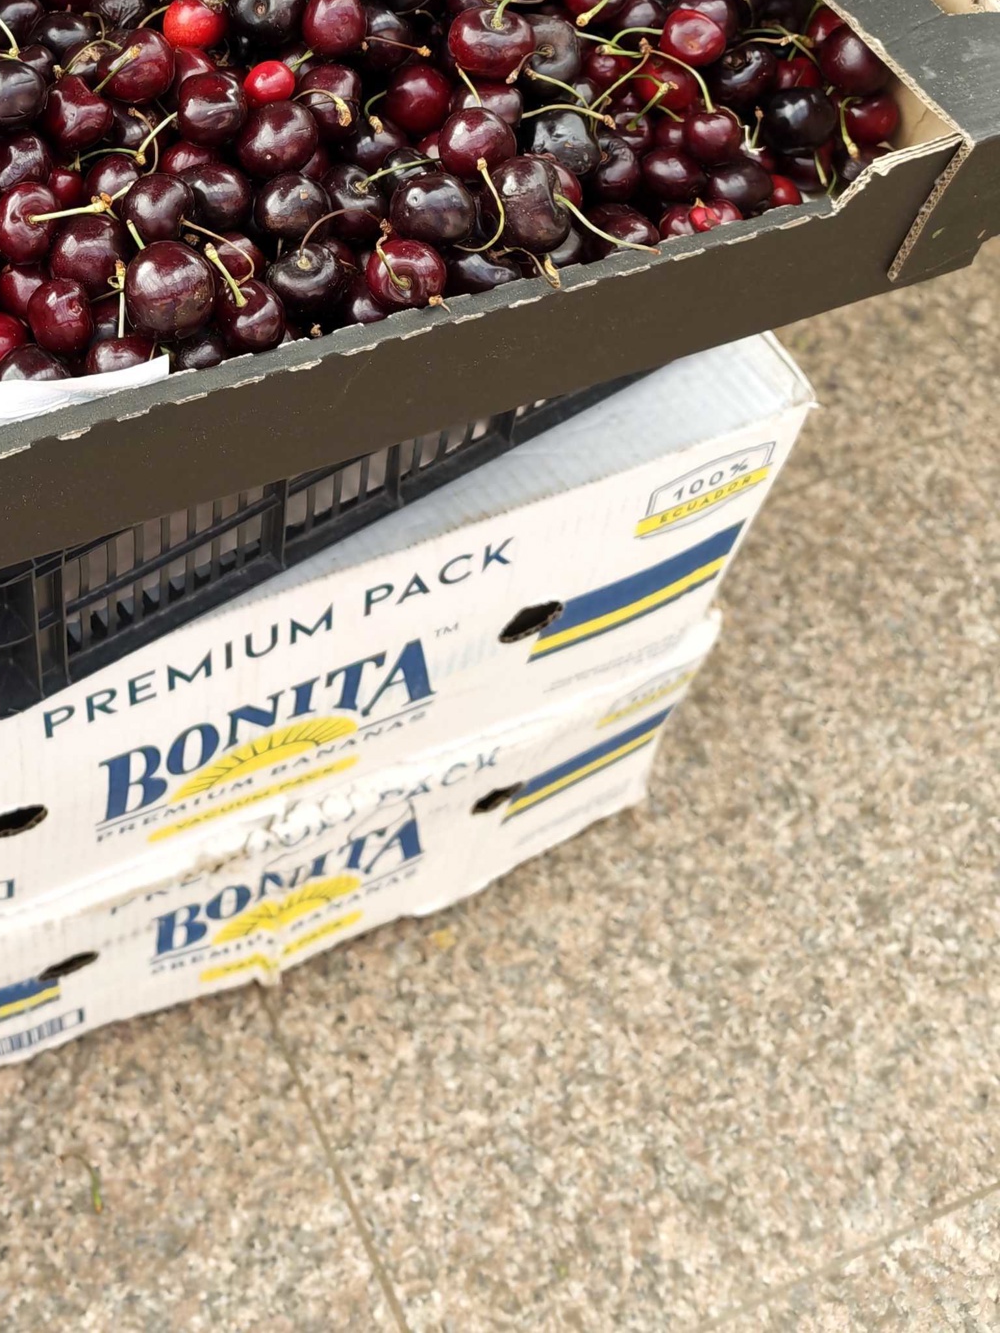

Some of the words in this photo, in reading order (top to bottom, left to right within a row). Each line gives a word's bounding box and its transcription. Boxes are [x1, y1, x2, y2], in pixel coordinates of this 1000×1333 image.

[659, 474, 752, 524] ECUADOR
[673, 458, 749, 502] 100%
[43, 603, 335, 739] PREMIUM
[364, 536, 515, 617] PACK
[96, 637, 438, 828] BONITA
[96, 775, 254, 843] PREMIUM
